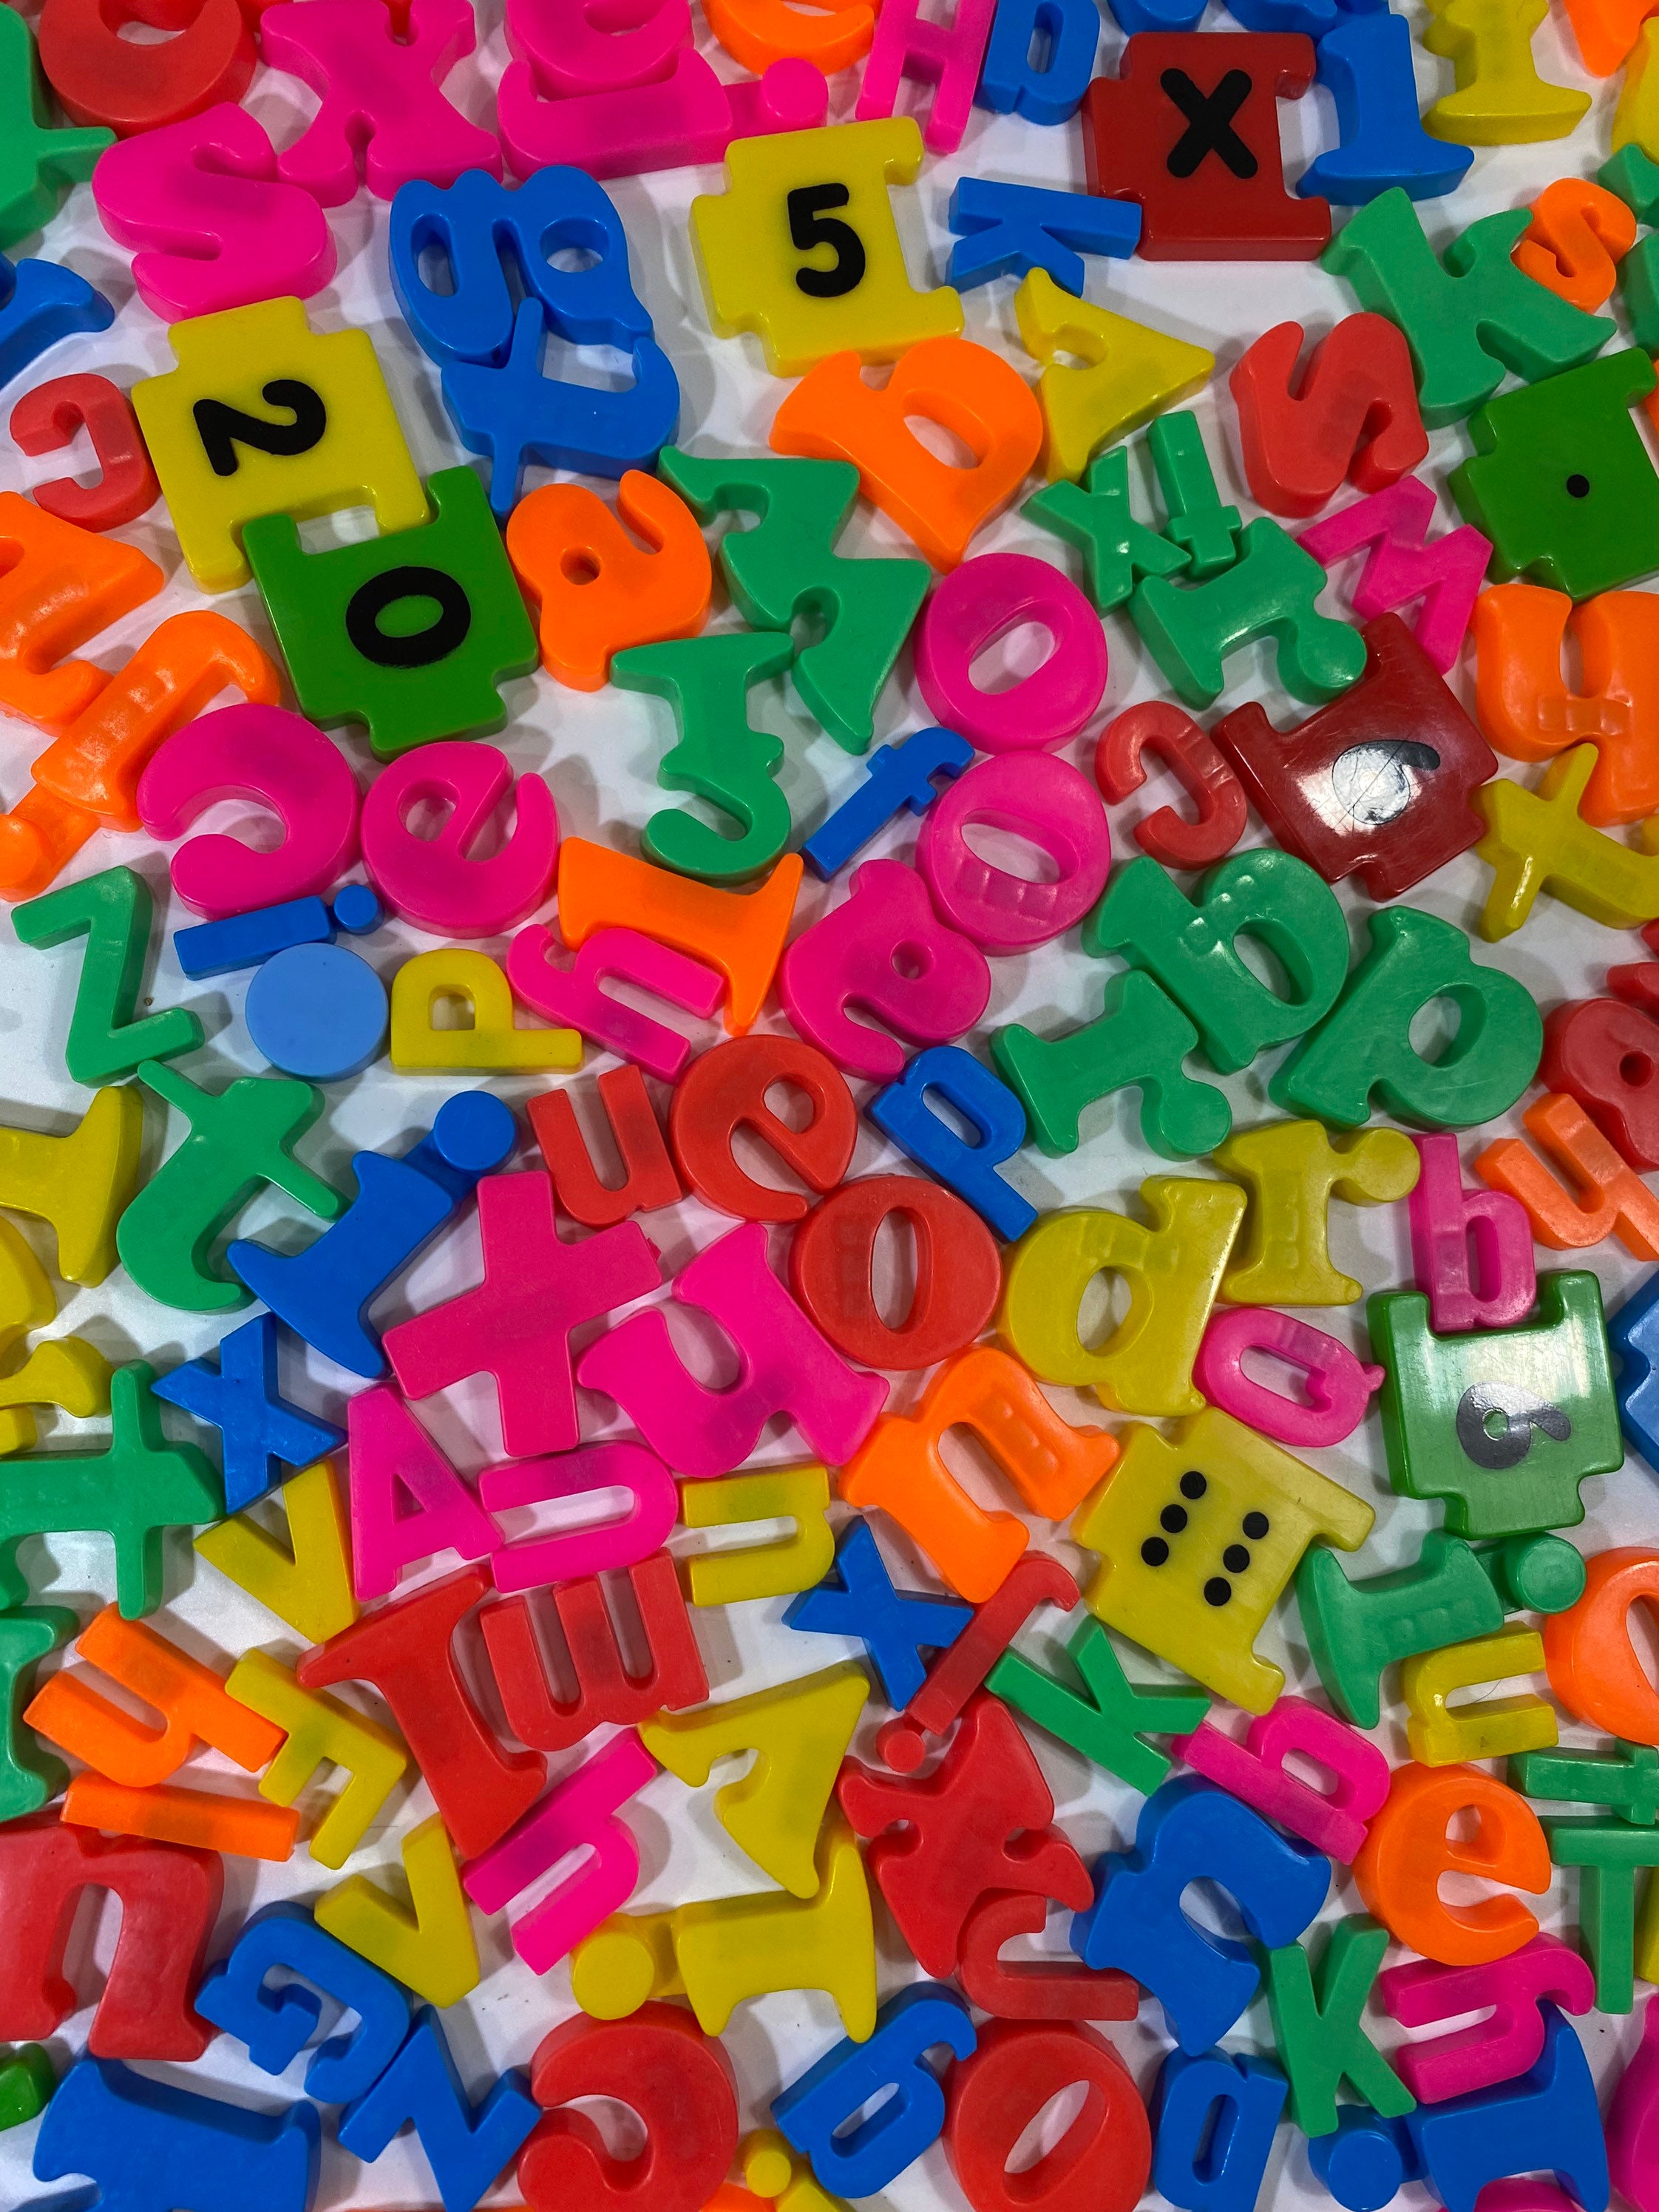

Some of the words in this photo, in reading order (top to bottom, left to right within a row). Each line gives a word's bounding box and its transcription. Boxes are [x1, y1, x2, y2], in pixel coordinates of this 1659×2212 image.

[787, 183, 866, 298] 5
[193, 379, 327, 477] 2
[173, 884, 385, 981] i
[359, 741, 561, 939] e
[669, 1034, 858, 1224] e
[225, 1090, 516, 1380] i
[347, 1382, 504, 1602] A
[225, 1647, 408, 1870] F
[570, 1826, 878, 2043] i
[1351, 1760, 1553, 1966] e
